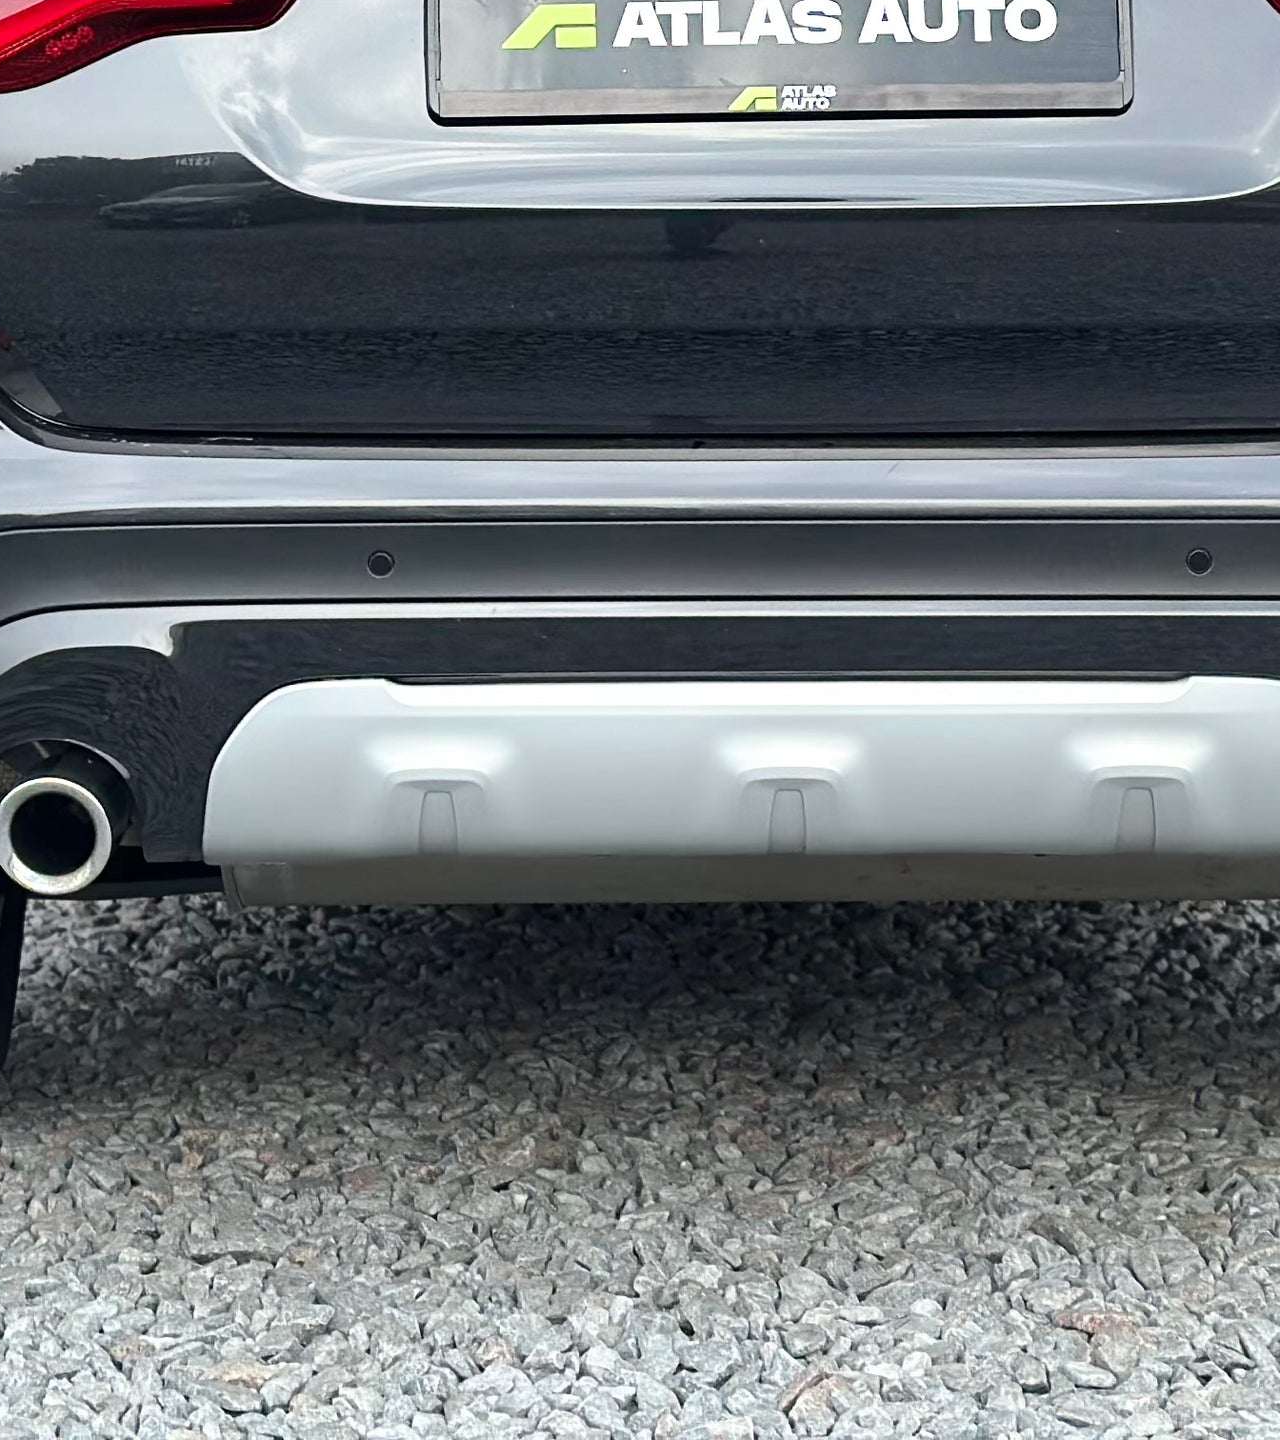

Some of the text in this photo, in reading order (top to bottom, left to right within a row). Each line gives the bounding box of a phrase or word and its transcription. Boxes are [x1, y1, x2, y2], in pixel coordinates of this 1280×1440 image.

[612, 0, 843, 48] ATLAS
[781, 85, 837, 97] ATLAS
[781, 97, 831, 111] AUTO
